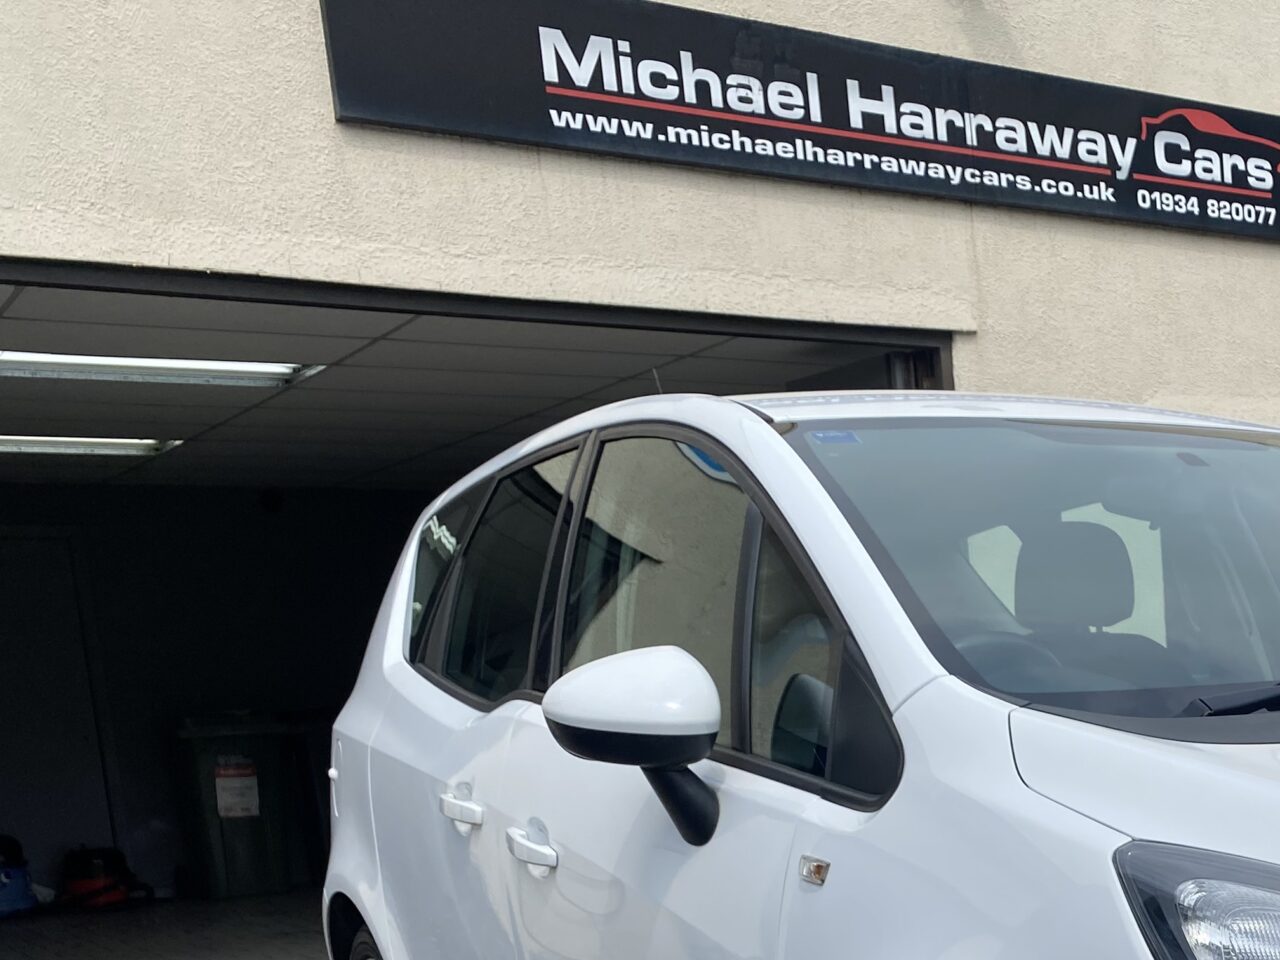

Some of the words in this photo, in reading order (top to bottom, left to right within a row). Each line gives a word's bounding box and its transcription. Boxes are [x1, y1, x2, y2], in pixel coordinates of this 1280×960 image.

[538, 26, 822, 123] Michael
[846, 78, 1138, 180] Harraway
[1153, 130, 1274, 190] Cars
[548, 108, 1117, 203] www.michaelharrawaycars.co.uk
[1136, 189, 1200, 216] 01934
[1206, 198, 1277, 226] 820077
